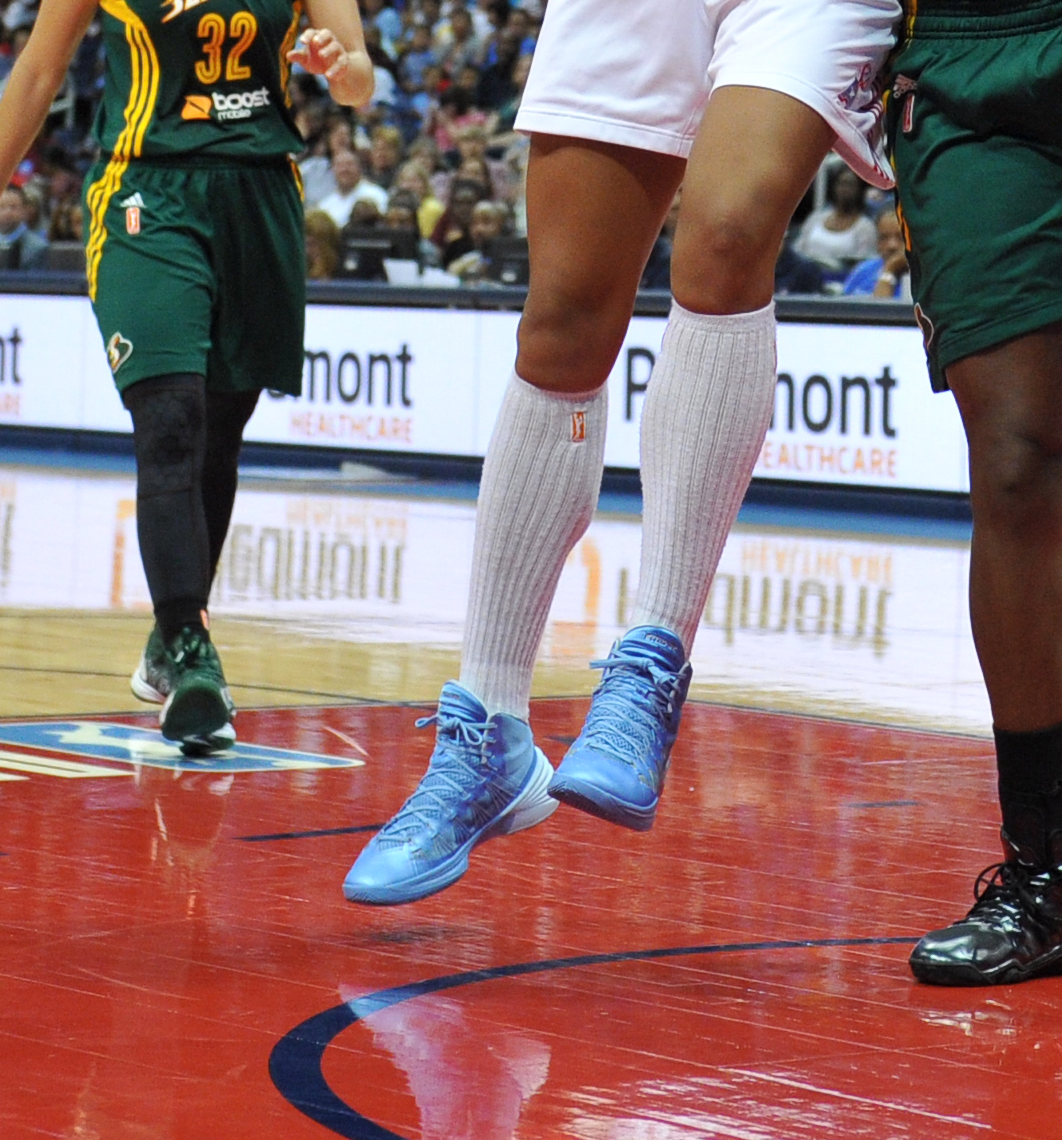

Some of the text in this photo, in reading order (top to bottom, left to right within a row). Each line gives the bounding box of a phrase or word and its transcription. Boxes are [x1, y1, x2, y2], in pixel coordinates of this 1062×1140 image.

[195, 11, 258, 85] 32
[211, 86, 270, 111] boost
[290, 413, 414, 443] HEALTHCARE
[762, 441, 898, 478] EALTHCARE
